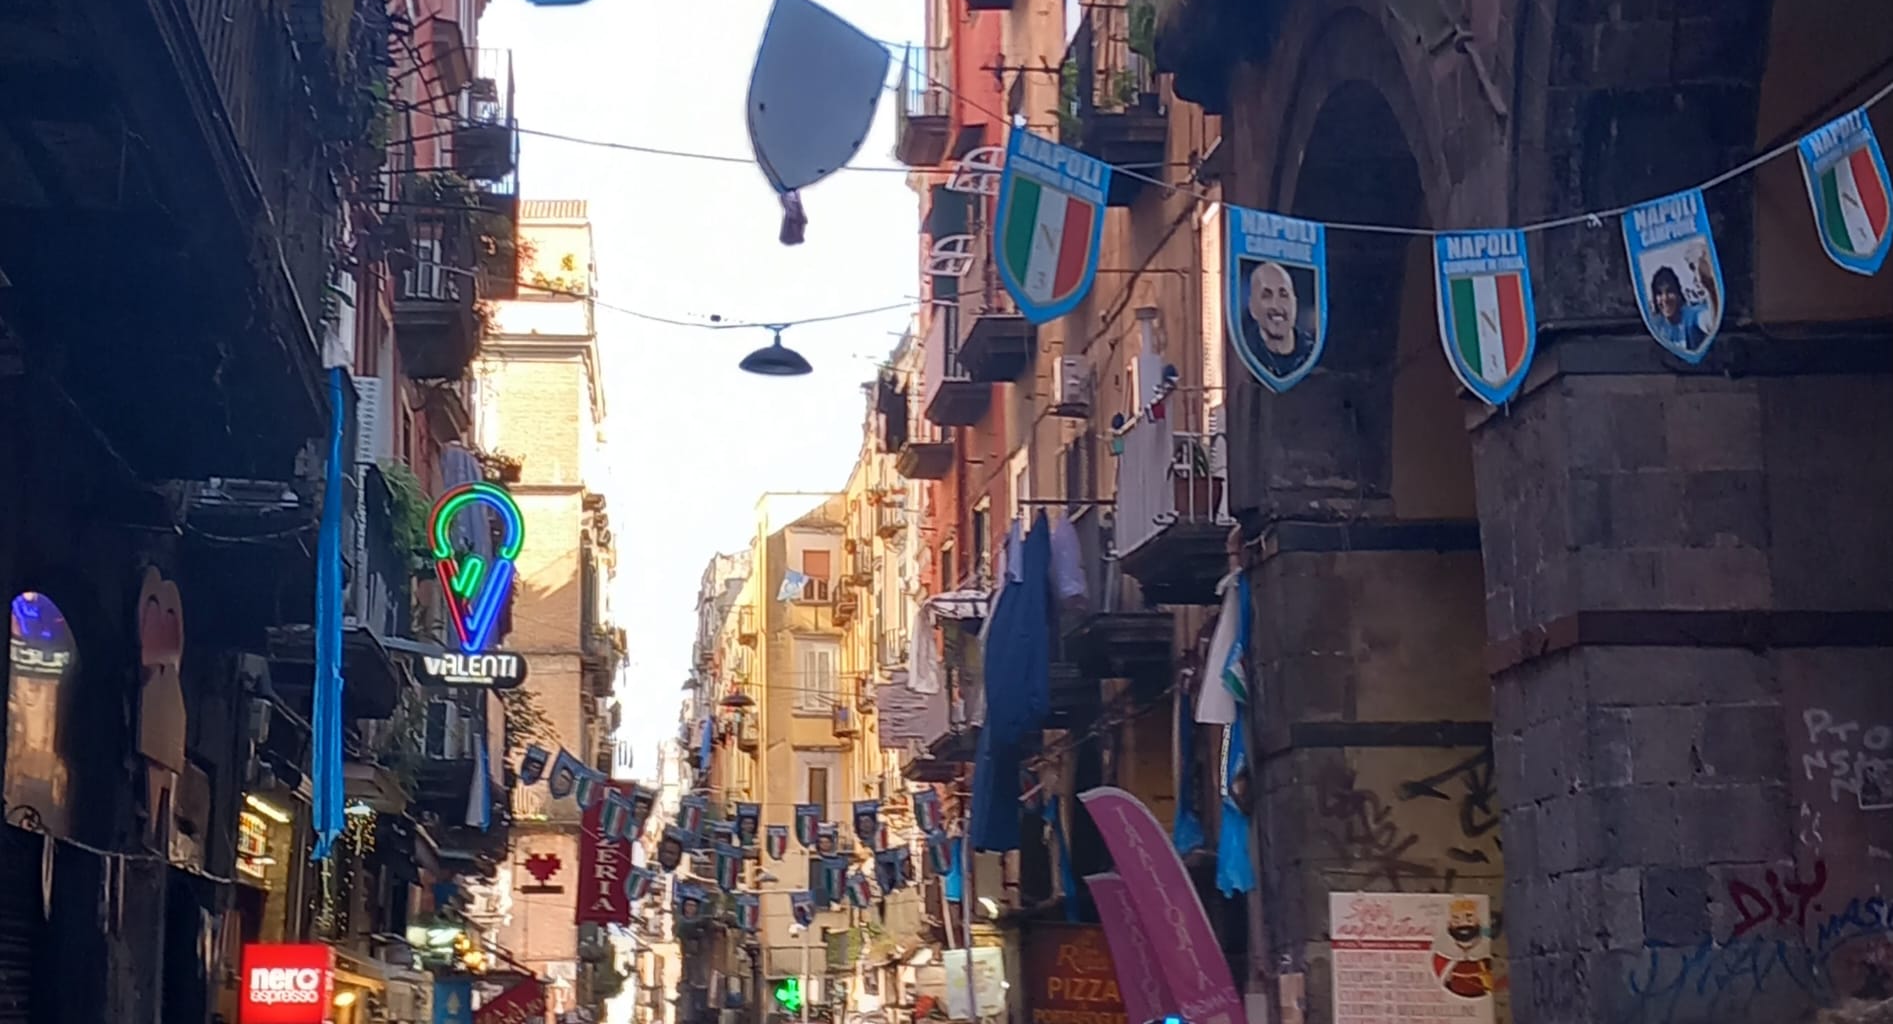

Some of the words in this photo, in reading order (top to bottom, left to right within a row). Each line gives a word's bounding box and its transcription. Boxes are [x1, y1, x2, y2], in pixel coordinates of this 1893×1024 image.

[1808, 110, 1862, 159] NAPOLI
[1019, 132, 1104, 185] NAPOLI
[1241, 208, 1317, 245] NAPOLI
[1633, 193, 1697, 232] NAPOLI
[1446, 232, 1517, 260] NAPOLI
[423, 653, 518, 678] VALENTI
[250, 967, 320, 991] nero
[1048, 976, 1121, 1003] PIZZA
[250, 989, 319, 1006] espresso
